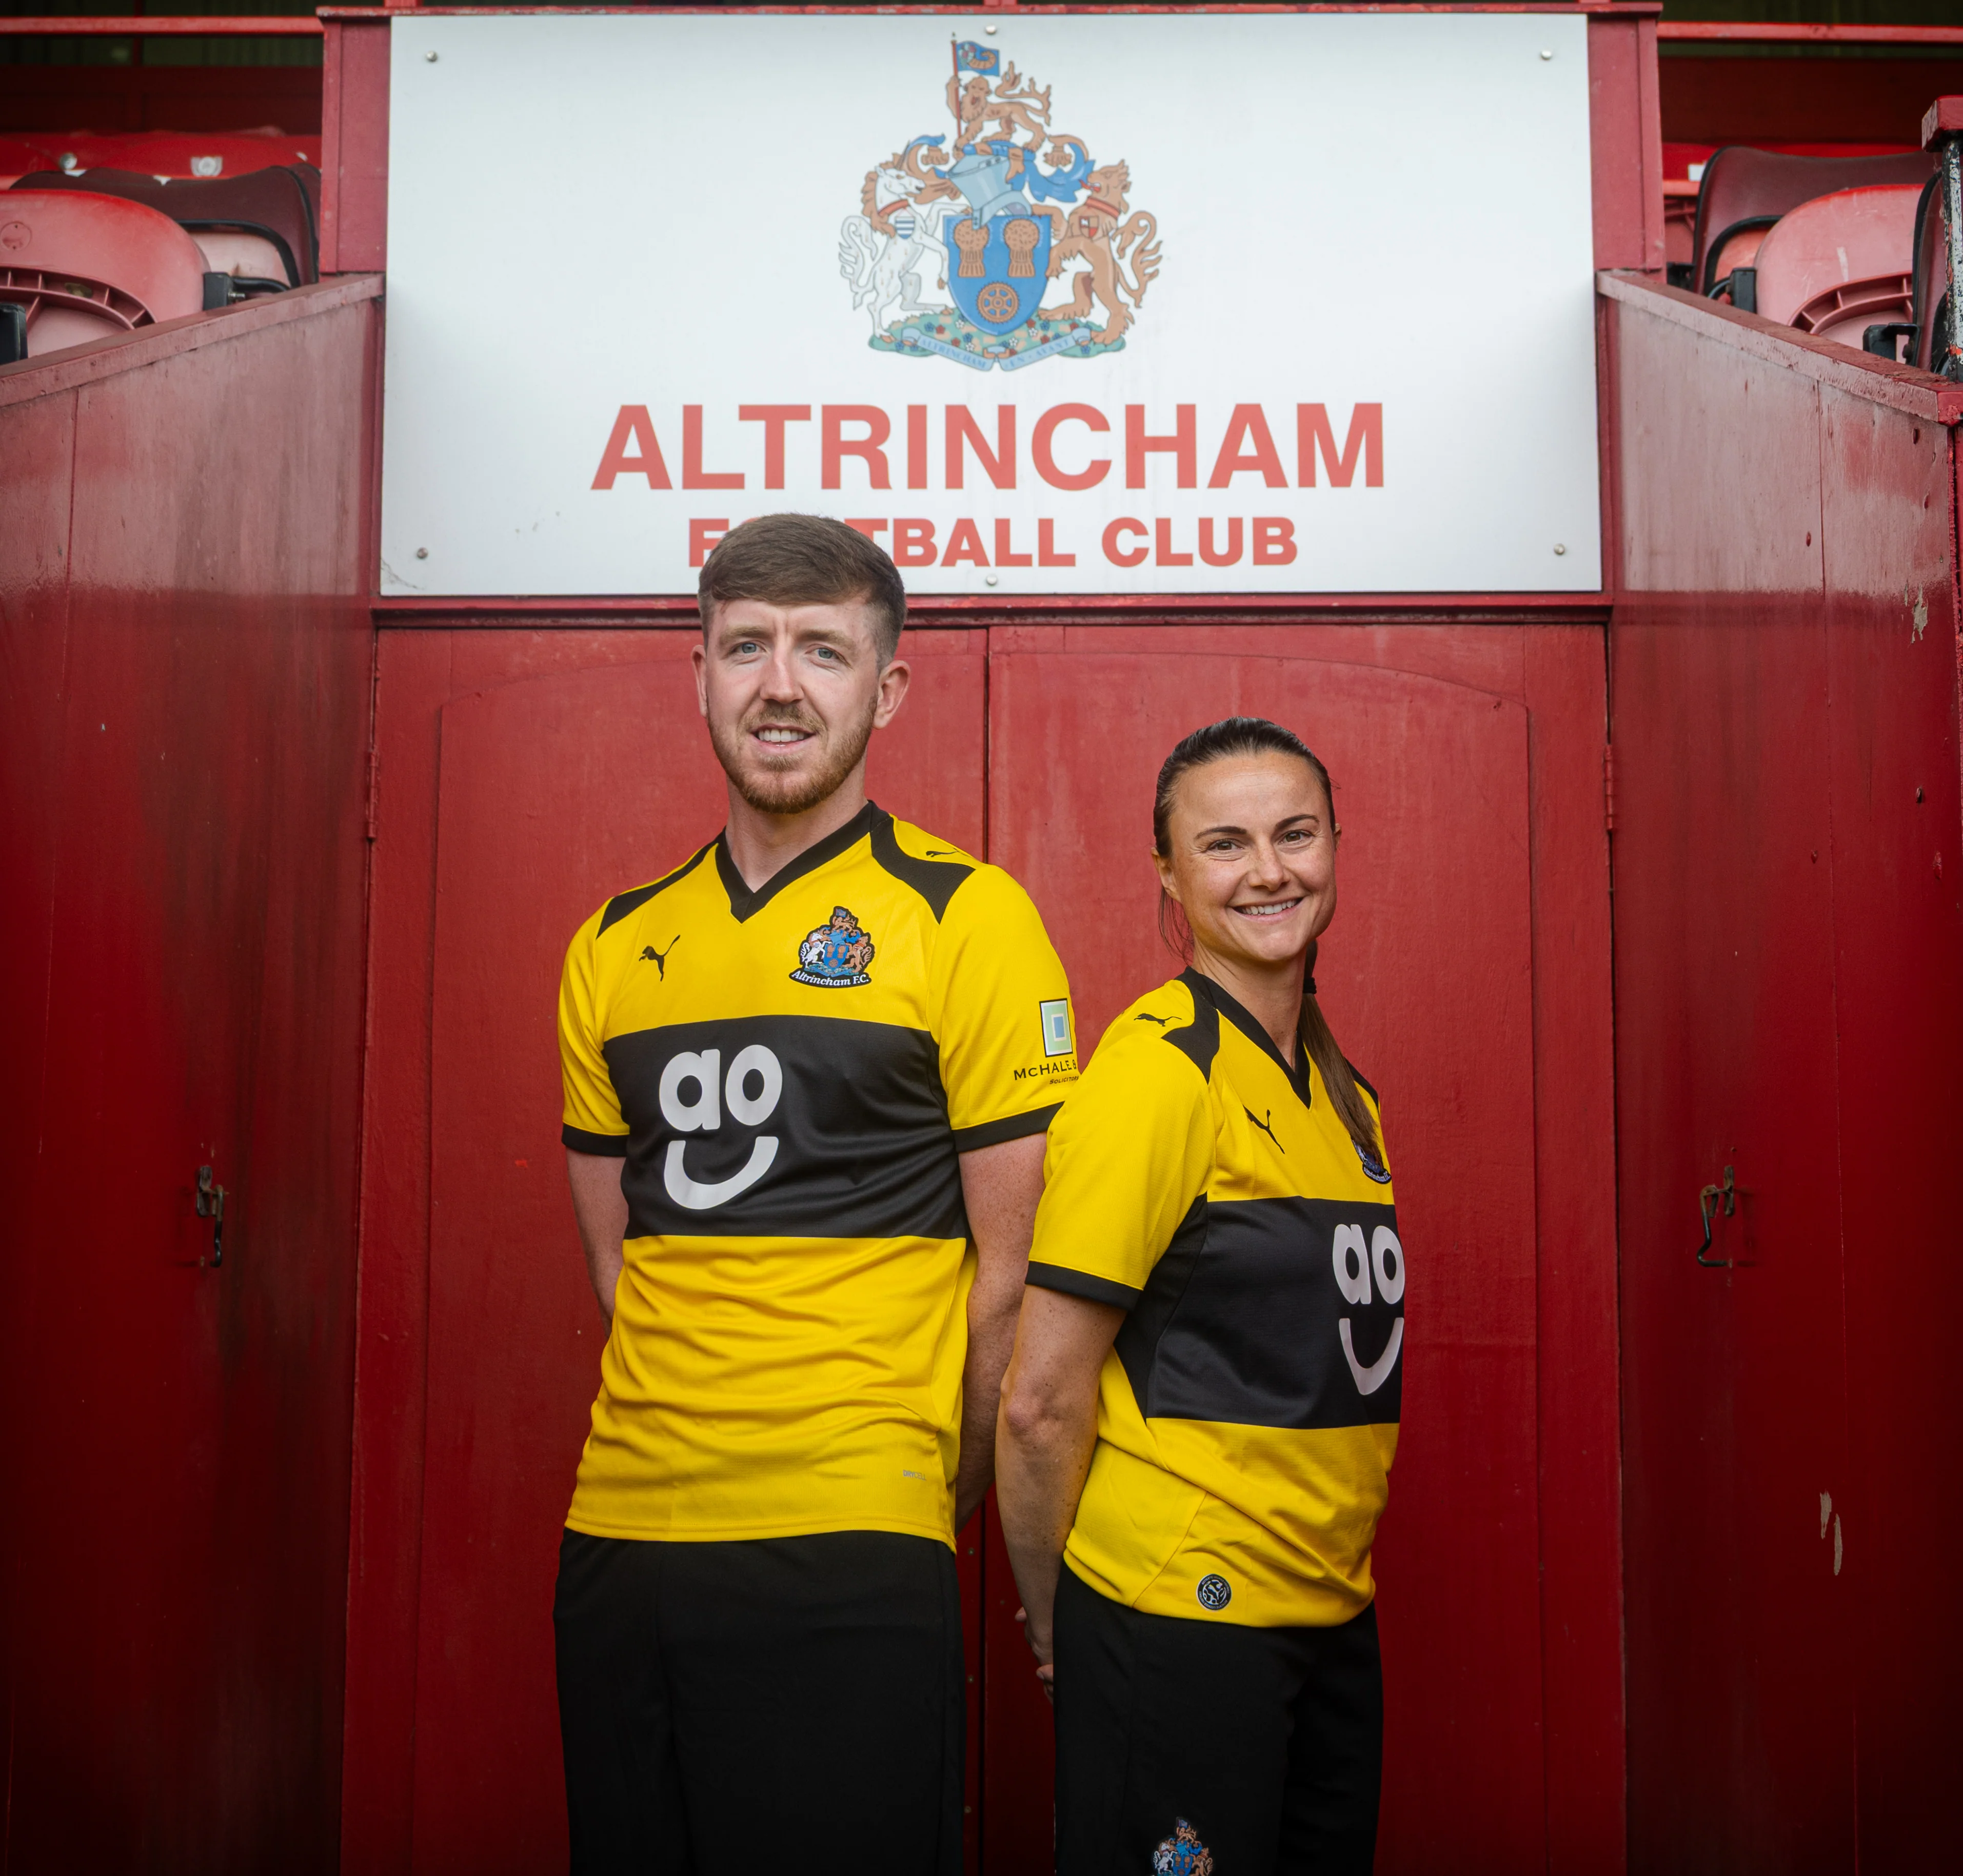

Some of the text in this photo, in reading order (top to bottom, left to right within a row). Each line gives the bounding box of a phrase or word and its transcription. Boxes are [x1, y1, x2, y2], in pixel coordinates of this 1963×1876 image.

[590, 403, 1384, 491] ALTRINCHAM
[688, 517, 1298, 568] FBALL CLUB
[791, 970, 869, 986] Altrincham F.C.
[659, 1044, 783, 1131] ao
[1332, 1224, 1405, 1304] ao
